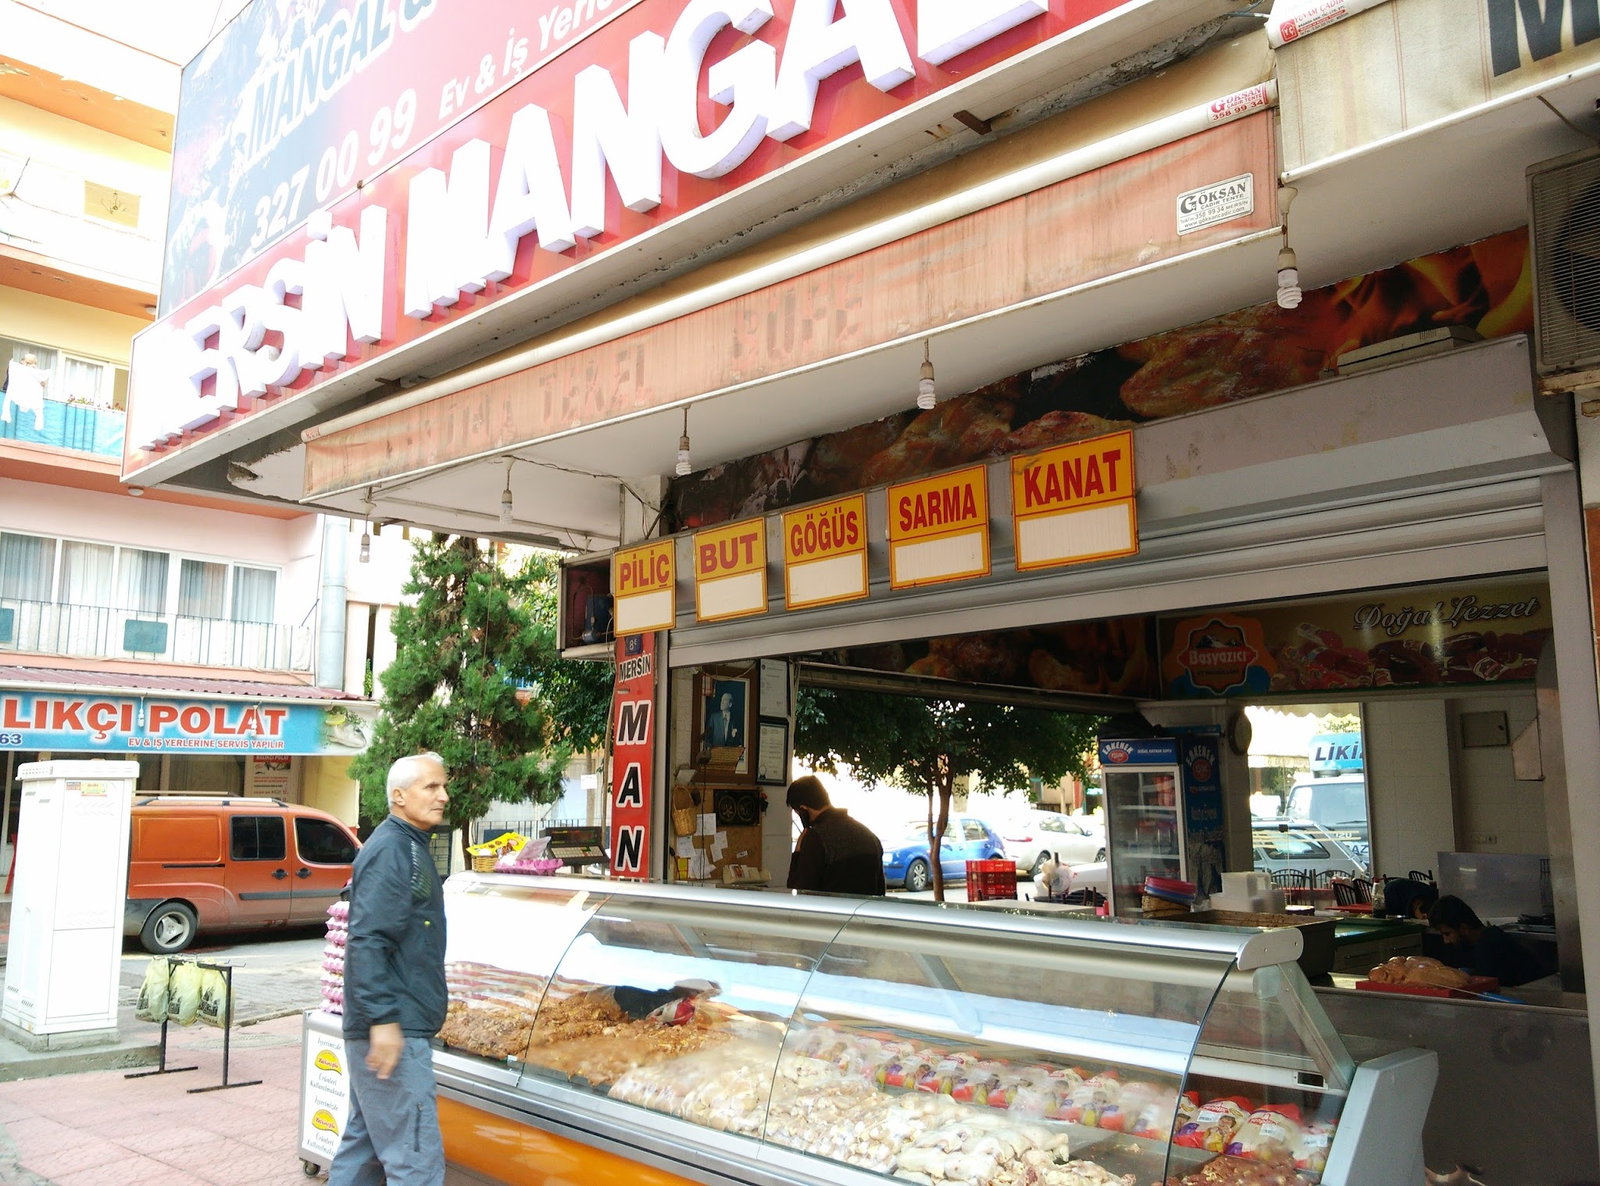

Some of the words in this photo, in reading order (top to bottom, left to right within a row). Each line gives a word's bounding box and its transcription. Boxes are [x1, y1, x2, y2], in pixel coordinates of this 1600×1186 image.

[247, 0, 394, 160] MANGAL
[438, 79, 468, 121] Ev
[474, 53, 496, 95] &
[1212, 110, 1232, 121] 358
[1234, 105, 1248, 114] 99
[1250, 99, 1264, 109] 34
[249, 163, 310, 250] 327
[315, 130, 359, 203] 00
[368, 88, 417, 167] 99
[1180, 182, 1246, 214] GÖKSAN
[1207, 208, 1216, 216] 99
[1222, 193, 1244, 204] TENTE
[1023, 449, 1122, 509] KANAT
[899, 483, 977, 532] SARMA
[790, 511, 859, 557] GÖĞÜS
[700, 532, 758, 575] BUT
[619, 551, 670, 591] PİLİÇ
[1440, 594, 1540, 629] Lezzet
[619, 650, 651, 684] MERSİN
[150, 706, 287, 736] POLAT
[129, 738, 142, 747] EV
[142, 738, 152, 747] &
[1315, 741, 1363, 761] LİKİ
[1345, 844, 1369, 857] AZ
